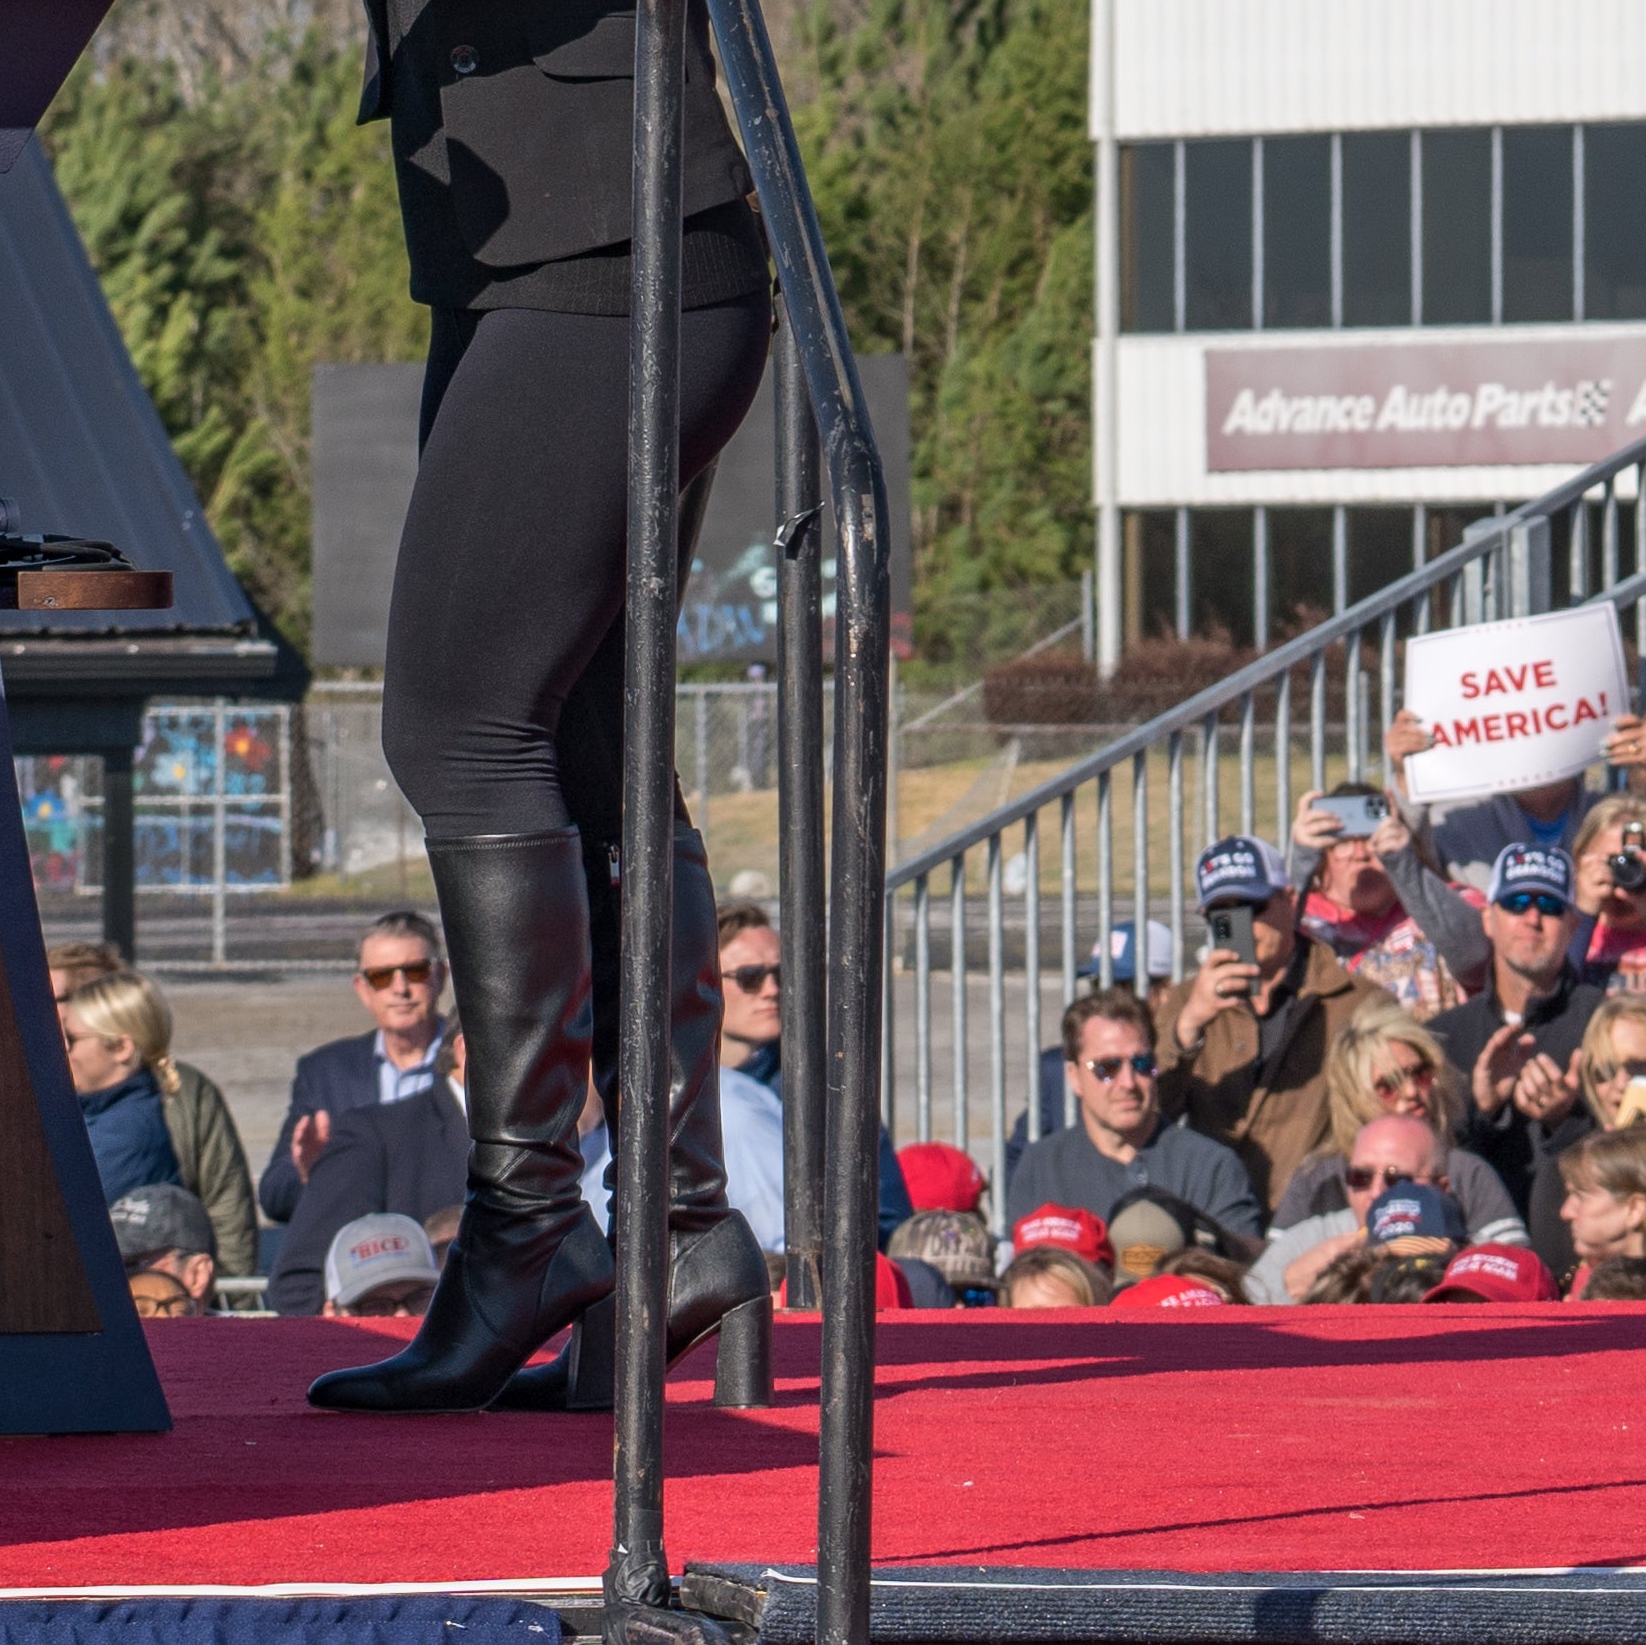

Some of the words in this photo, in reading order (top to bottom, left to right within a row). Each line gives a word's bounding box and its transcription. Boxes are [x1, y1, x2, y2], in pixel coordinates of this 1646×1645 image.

[1221, 387, 1375, 433] Advance
[1375, 384, 1471, 432] Auto
[1472, 380, 1576, 429] Parts
[1460, 659, 1557, 699] SAVE
[1431, 692, 1609, 748] AMERICA!
